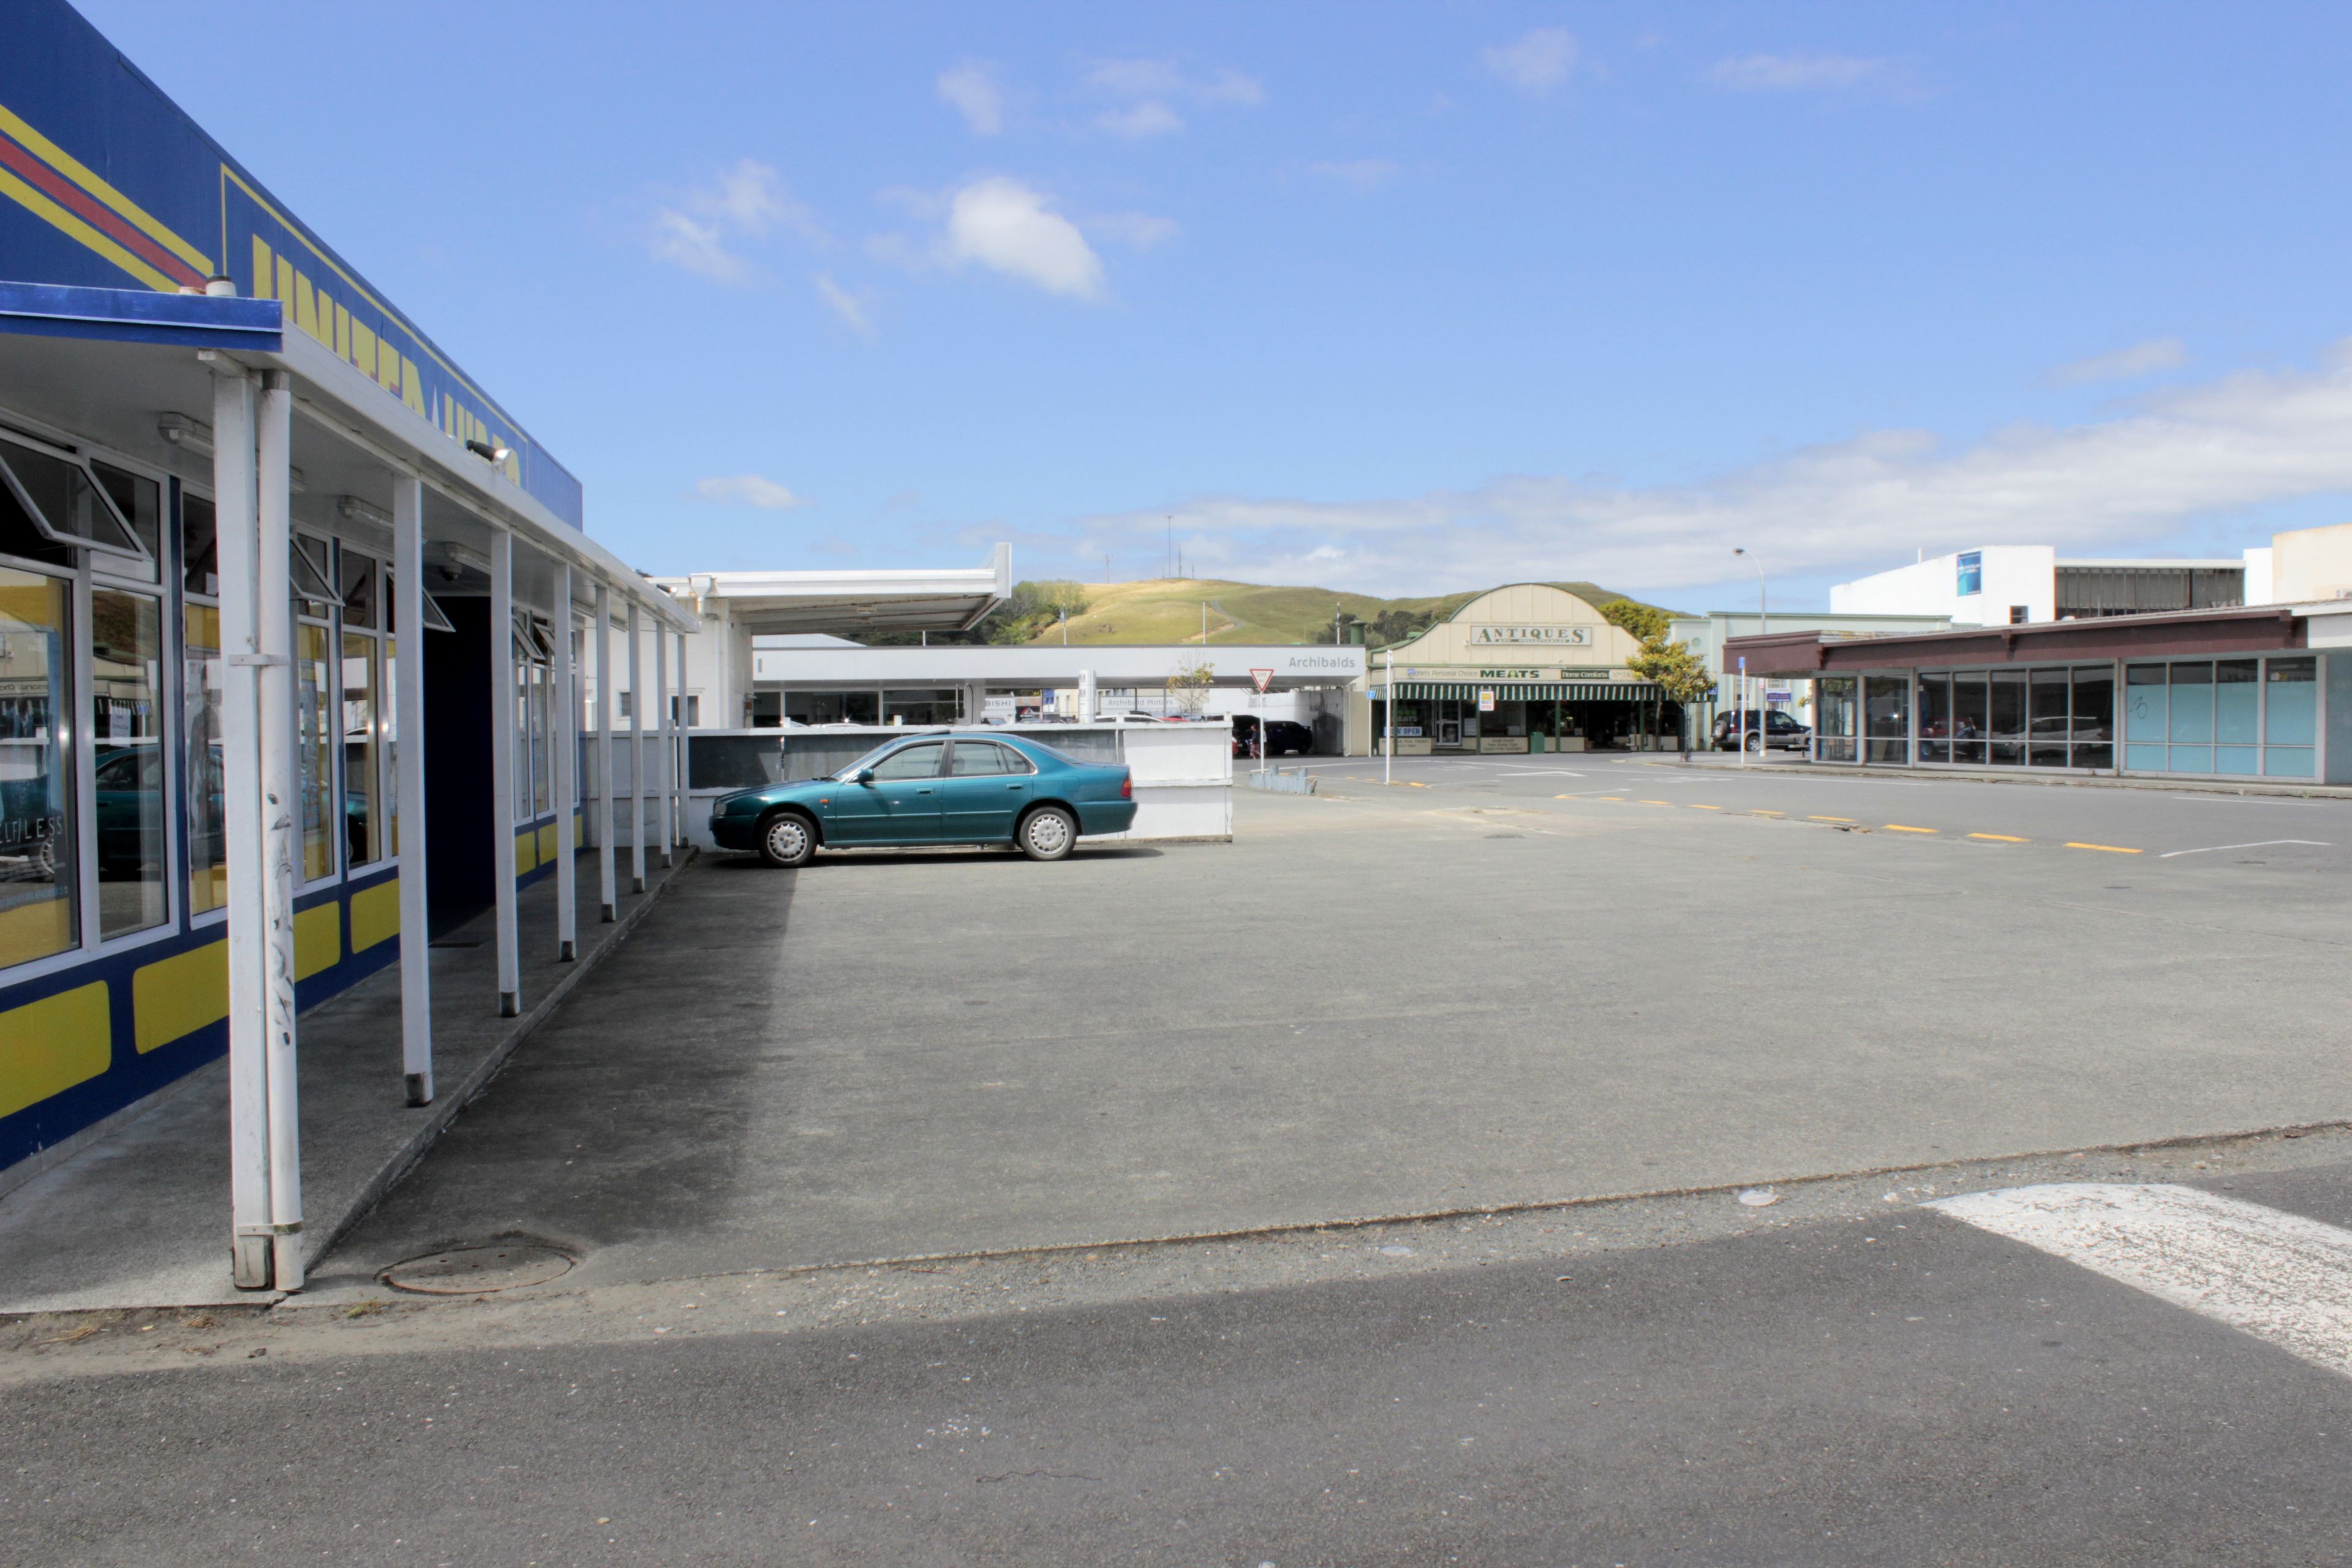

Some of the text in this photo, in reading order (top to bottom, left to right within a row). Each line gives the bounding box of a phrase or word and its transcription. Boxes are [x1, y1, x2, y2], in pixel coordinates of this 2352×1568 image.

[1477, 628, 1584, 643] ANTIQUES
[1289, 657, 1355, 668] Archibalds
[1480, 669, 1540, 678] MEATS
